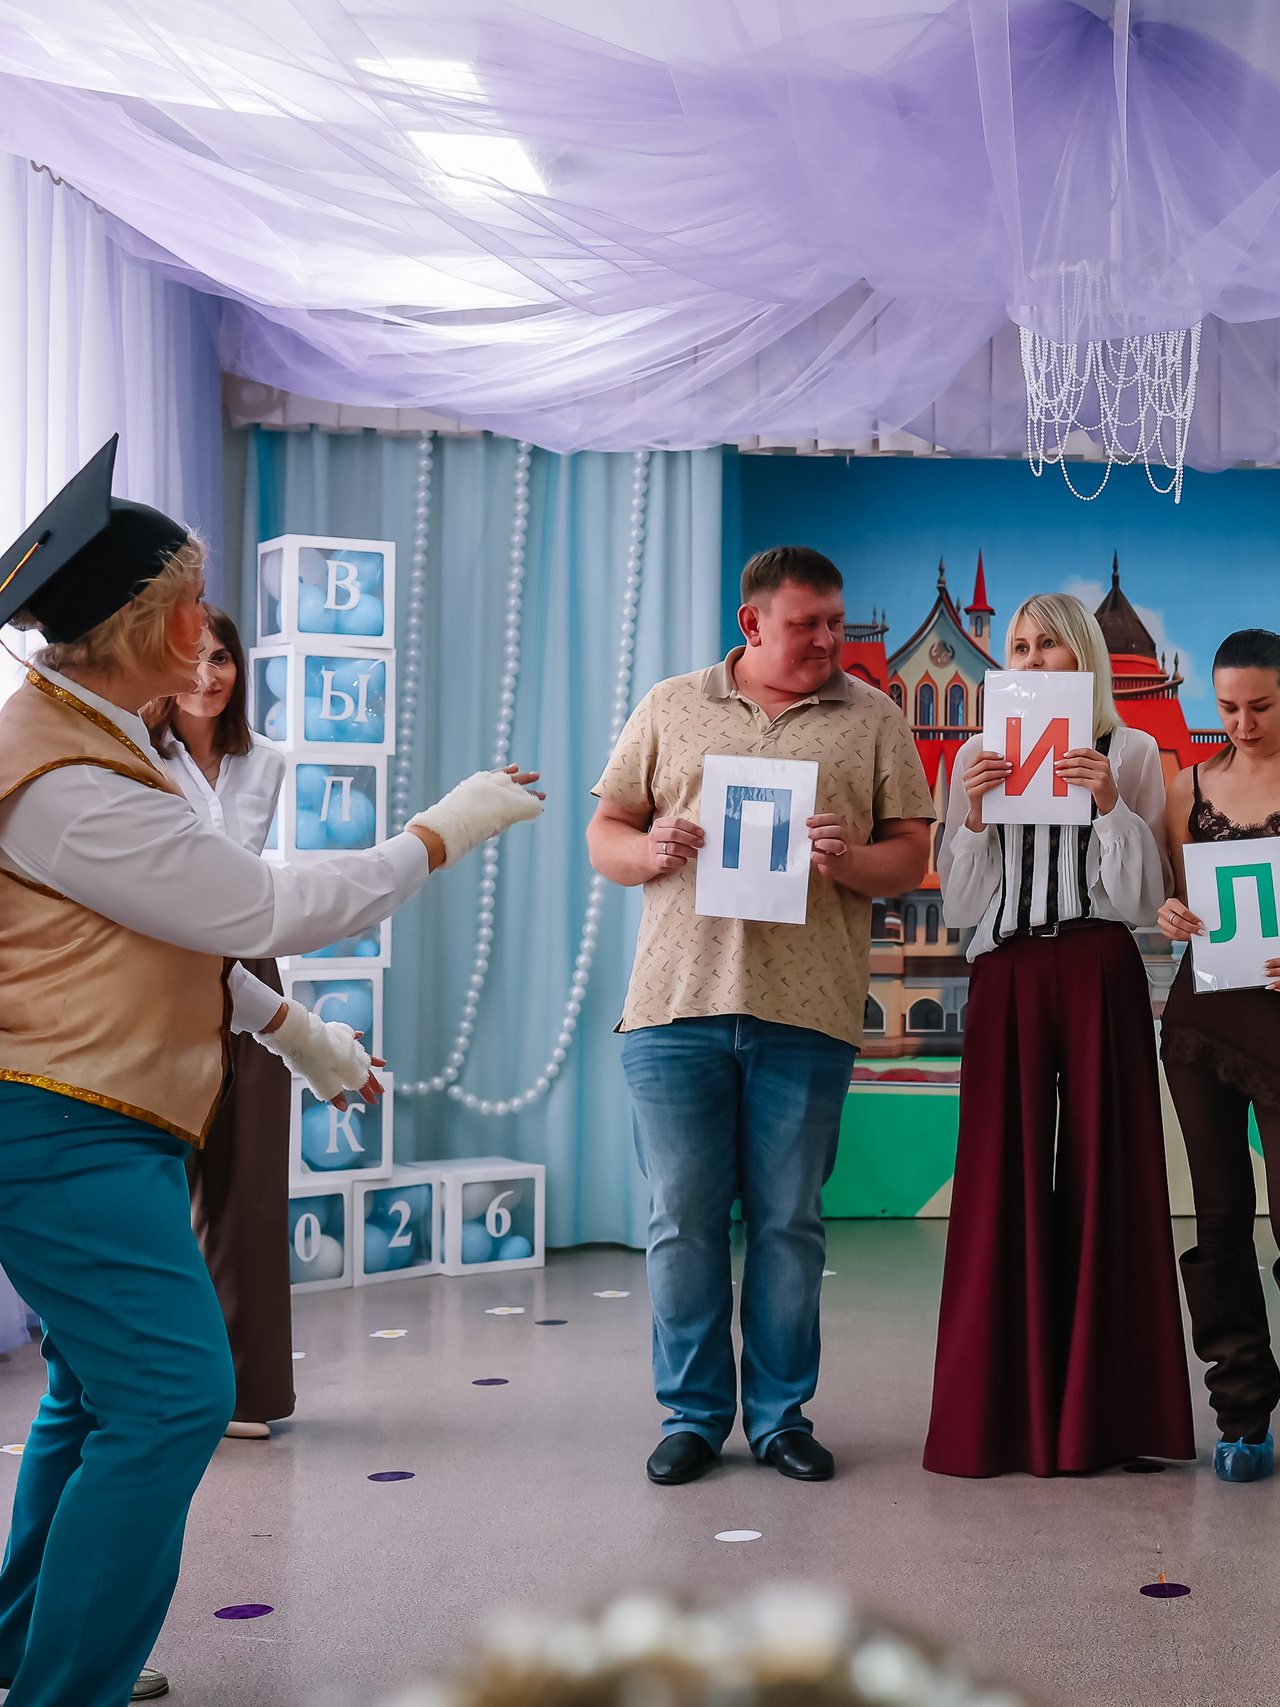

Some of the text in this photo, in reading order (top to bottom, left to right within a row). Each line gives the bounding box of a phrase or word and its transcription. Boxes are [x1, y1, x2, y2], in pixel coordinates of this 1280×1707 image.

[1005, 717, 1069, 797] И
[721, 785, 792, 873] П
[1209, 862, 1279, 944] Л
